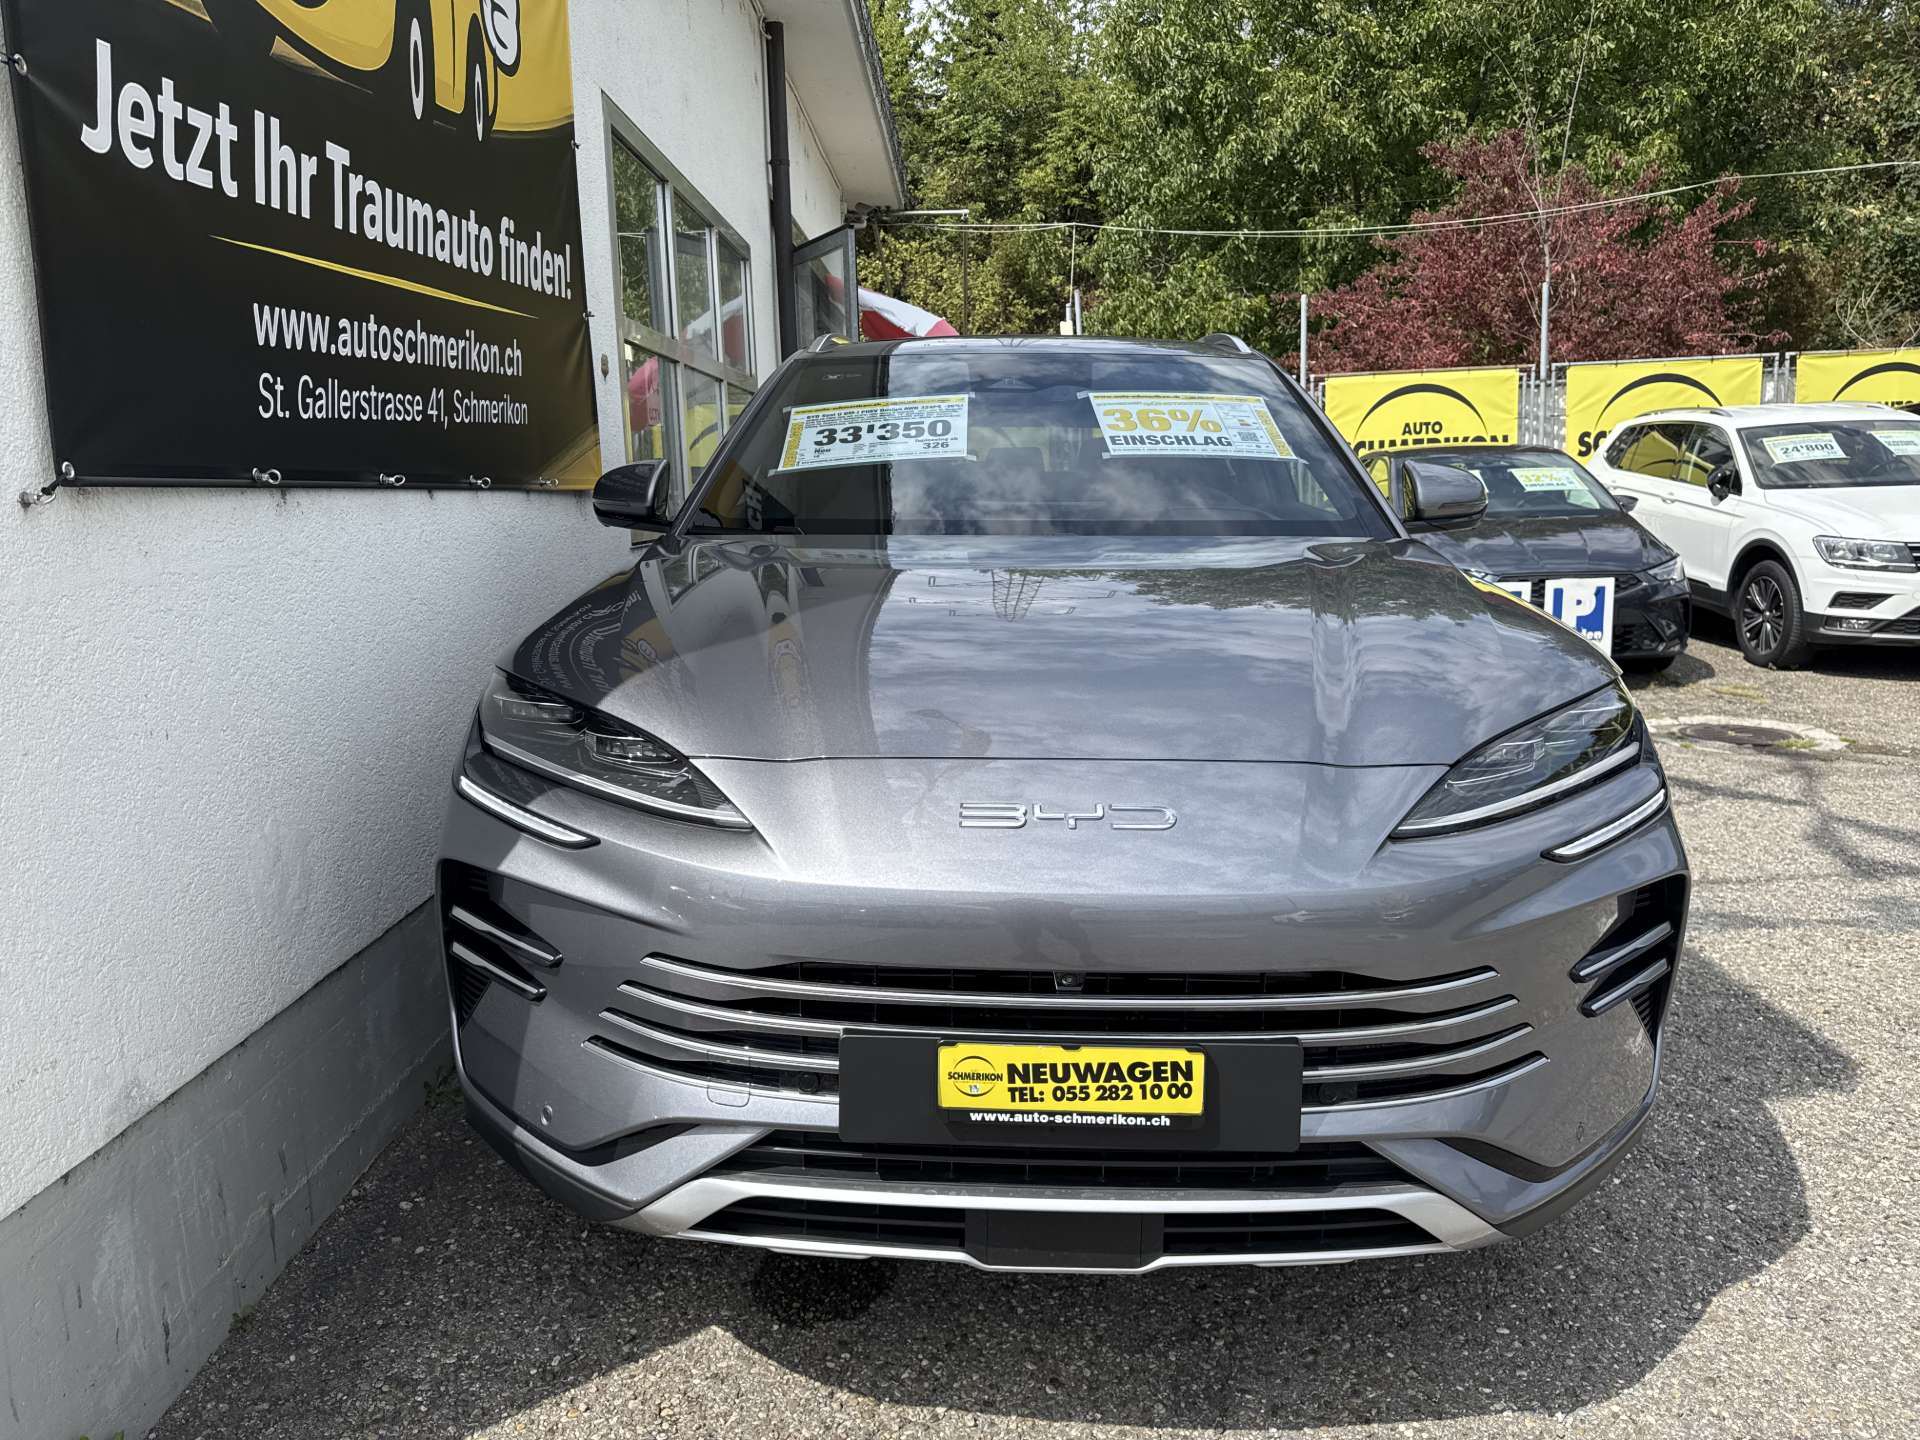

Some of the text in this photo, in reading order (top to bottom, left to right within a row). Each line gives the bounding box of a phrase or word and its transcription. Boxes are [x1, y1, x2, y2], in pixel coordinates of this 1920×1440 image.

[80, 37, 572, 301] Jetzt Ihr Traumauto finden!
[253, 302, 523, 377] www.autoschmerikon.ch
[258, 372, 529, 430] St. Gallerstrasse 41, Schmerikon
[1103, 408, 1223, 433] 36%
[1401, 420, 1443, 436] AUTO
[813, 419, 952, 447] 33'350
[1109, 434, 1233, 447] EINSCHLAG
[922, 442, 950, 450] 326
[1780, 442, 1834, 455] 24'800
[959, 802, 1178, 830] BYD
[947, 1071, 1003, 1082] SCHMERIKON
[1007, 1060, 1194, 1085] NEUWAGEN
[1007, 1082, 1194, 1103] TEL: 055 282 10 00
[969, 1110, 1171, 1127] www.auto-schmerikon.ch
